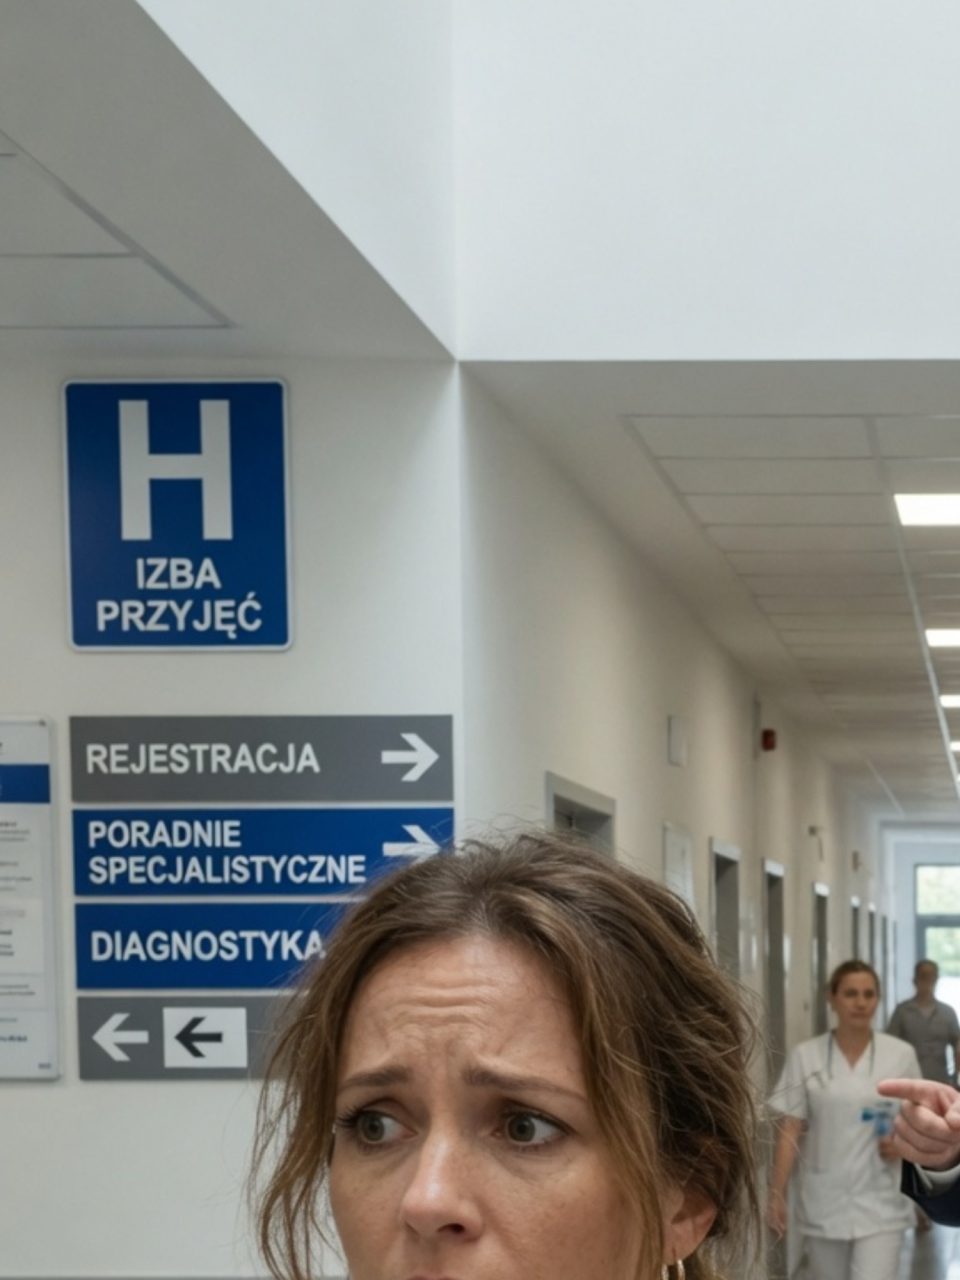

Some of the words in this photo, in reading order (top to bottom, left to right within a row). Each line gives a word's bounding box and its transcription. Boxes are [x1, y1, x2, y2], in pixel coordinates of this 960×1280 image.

[118, 399, 234, 541] H
[136, 557, 222, 590] IZBA
[97, 591, 262, 640] PRZYJĘĆ
[85, 742, 321, 775] REJESTRACJA
[88, 820, 242, 849] PORADNIE
[88, 854, 367, 885] SPECJALISTYCZNE
[90, 929, 327, 961] DIAGNOSTYKA
